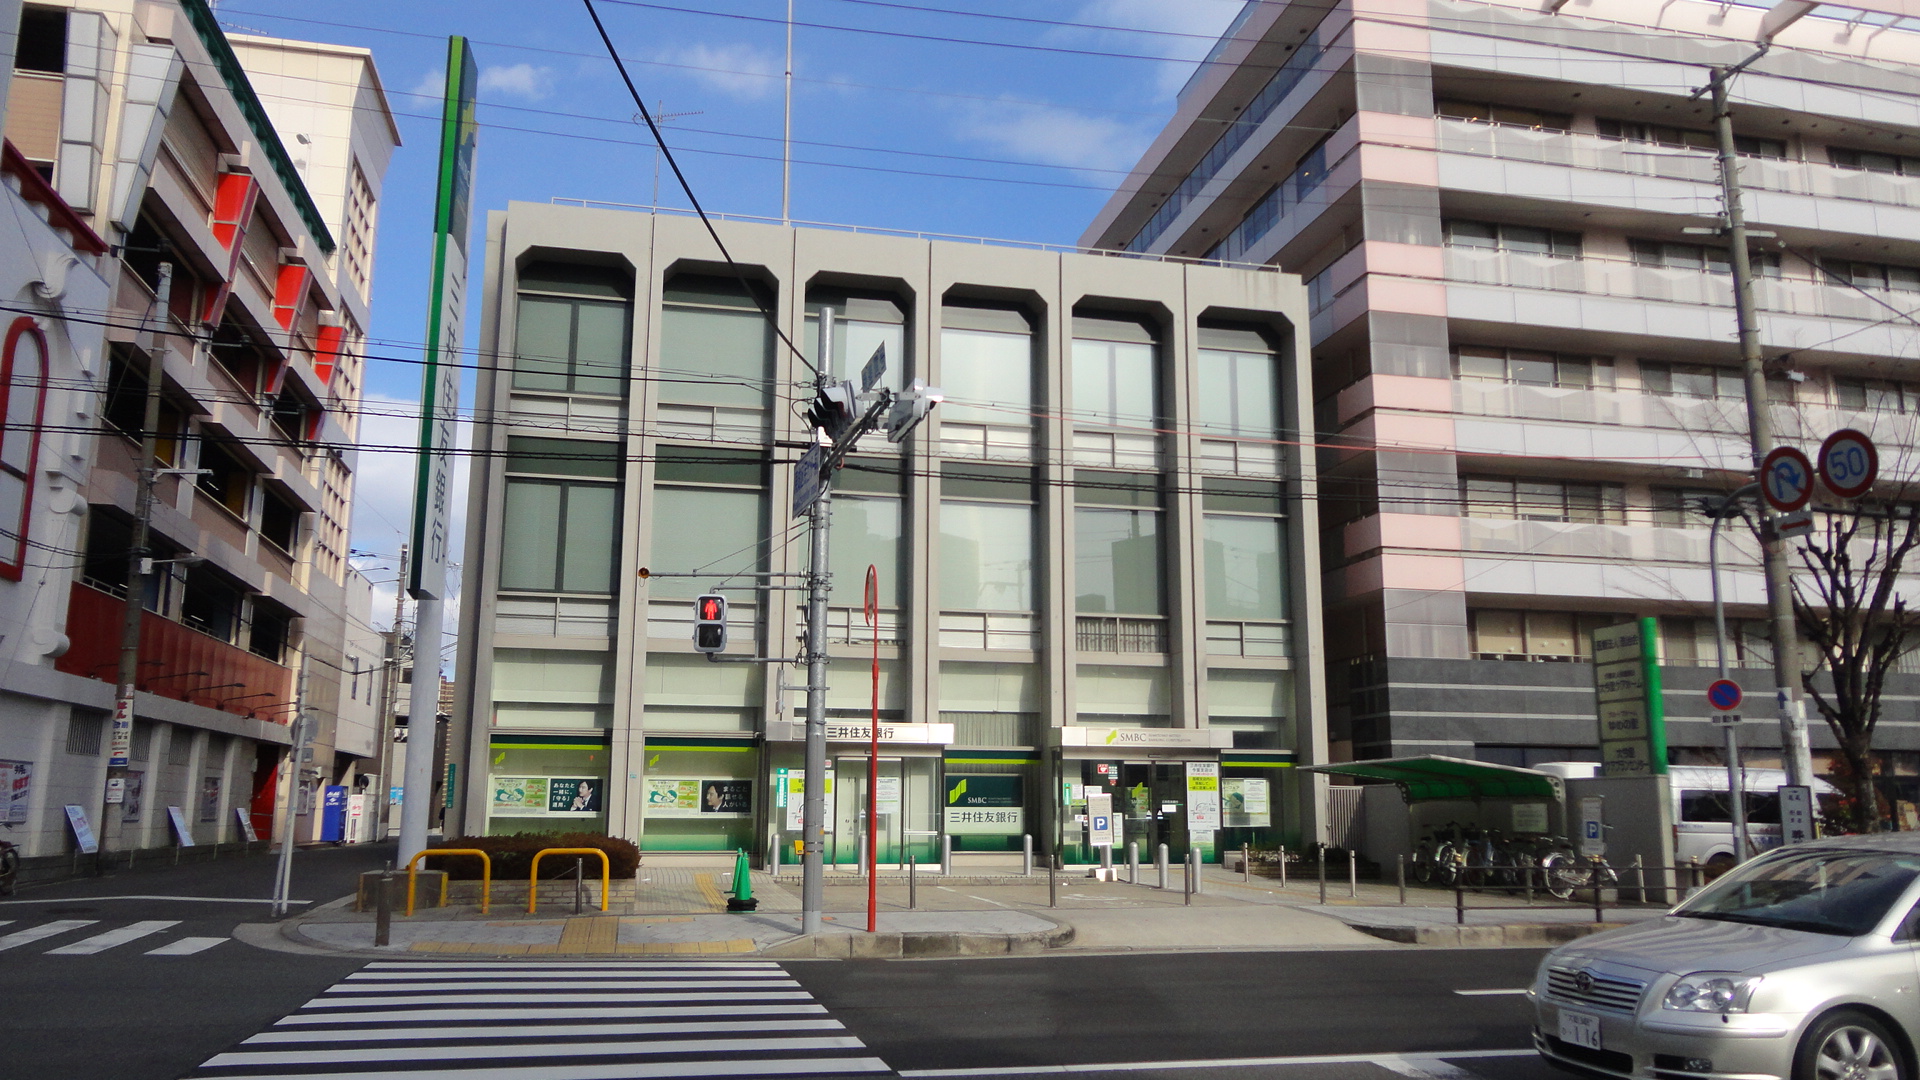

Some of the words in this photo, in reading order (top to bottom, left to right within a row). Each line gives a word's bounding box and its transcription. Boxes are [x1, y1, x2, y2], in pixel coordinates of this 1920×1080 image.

[1829, 446, 1865, 481] 50
[1120, 733, 1146, 742] SMBC
[950, 811, 1018, 823] 三井住友銀行
[1097, 818, 1105, 829] P
[1590, 823, 1598, 837] P
